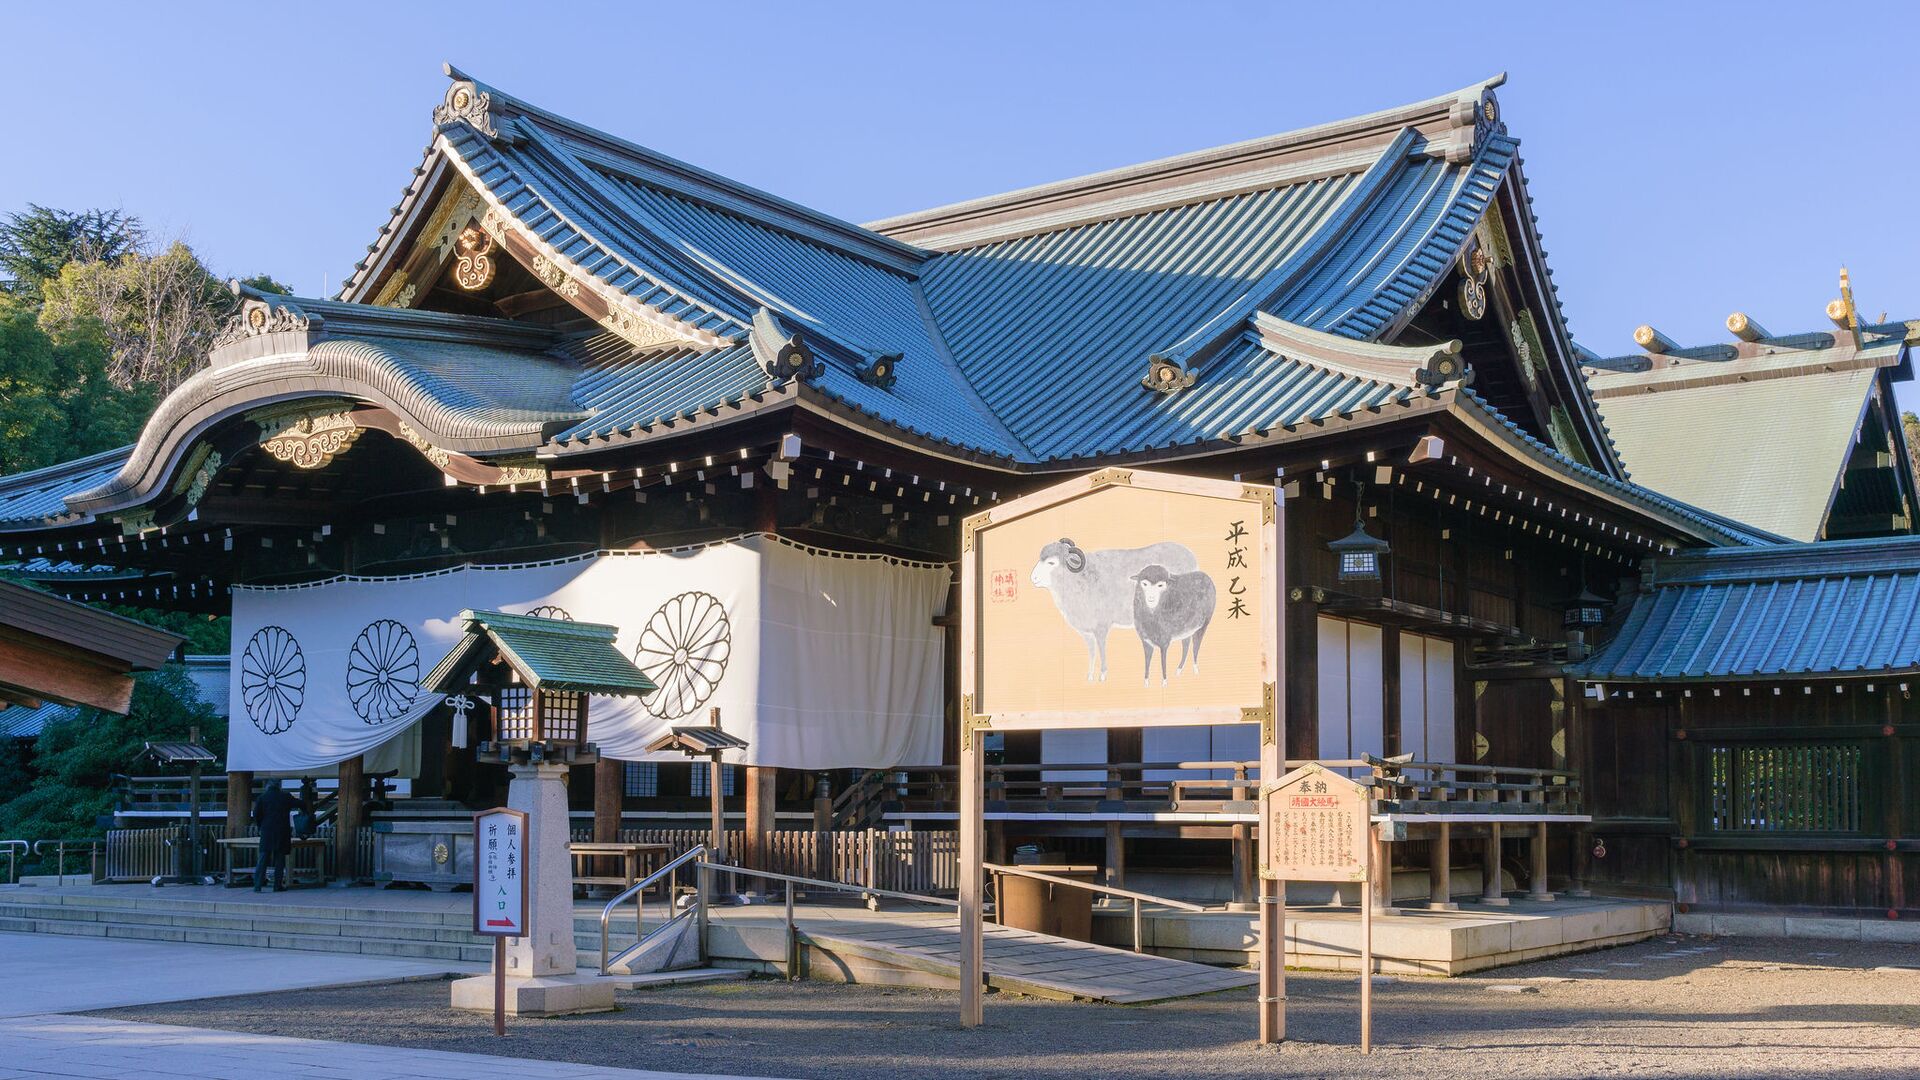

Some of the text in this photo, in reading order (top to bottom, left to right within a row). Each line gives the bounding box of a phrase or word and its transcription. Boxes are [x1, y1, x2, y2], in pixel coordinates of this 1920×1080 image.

[1225, 520, 1251, 619] 平成乙未
[1299, 780, 1327, 794] 奉納
[488, 823, 498, 851] 祈願
[507, 823, 517, 880] 個人参拝
[497, 885, 507, 910] 入口
